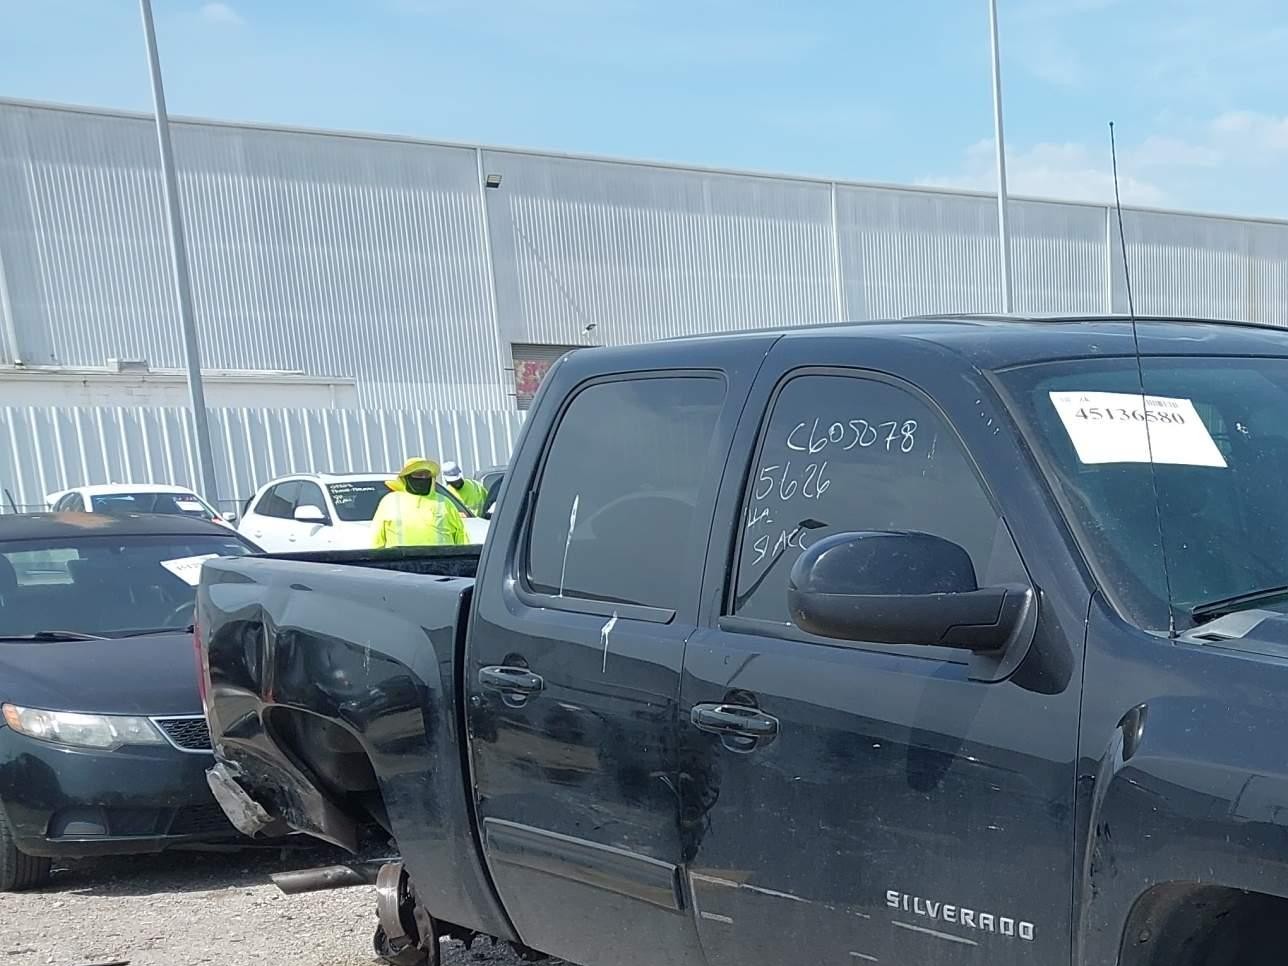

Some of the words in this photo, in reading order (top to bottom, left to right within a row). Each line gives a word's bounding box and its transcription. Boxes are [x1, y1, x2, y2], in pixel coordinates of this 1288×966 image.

[1075, 407, 1185, 425] 45136580
[755, 461, 831, 500] 5626
[886, 889, 1035, 941] SILVERADO
